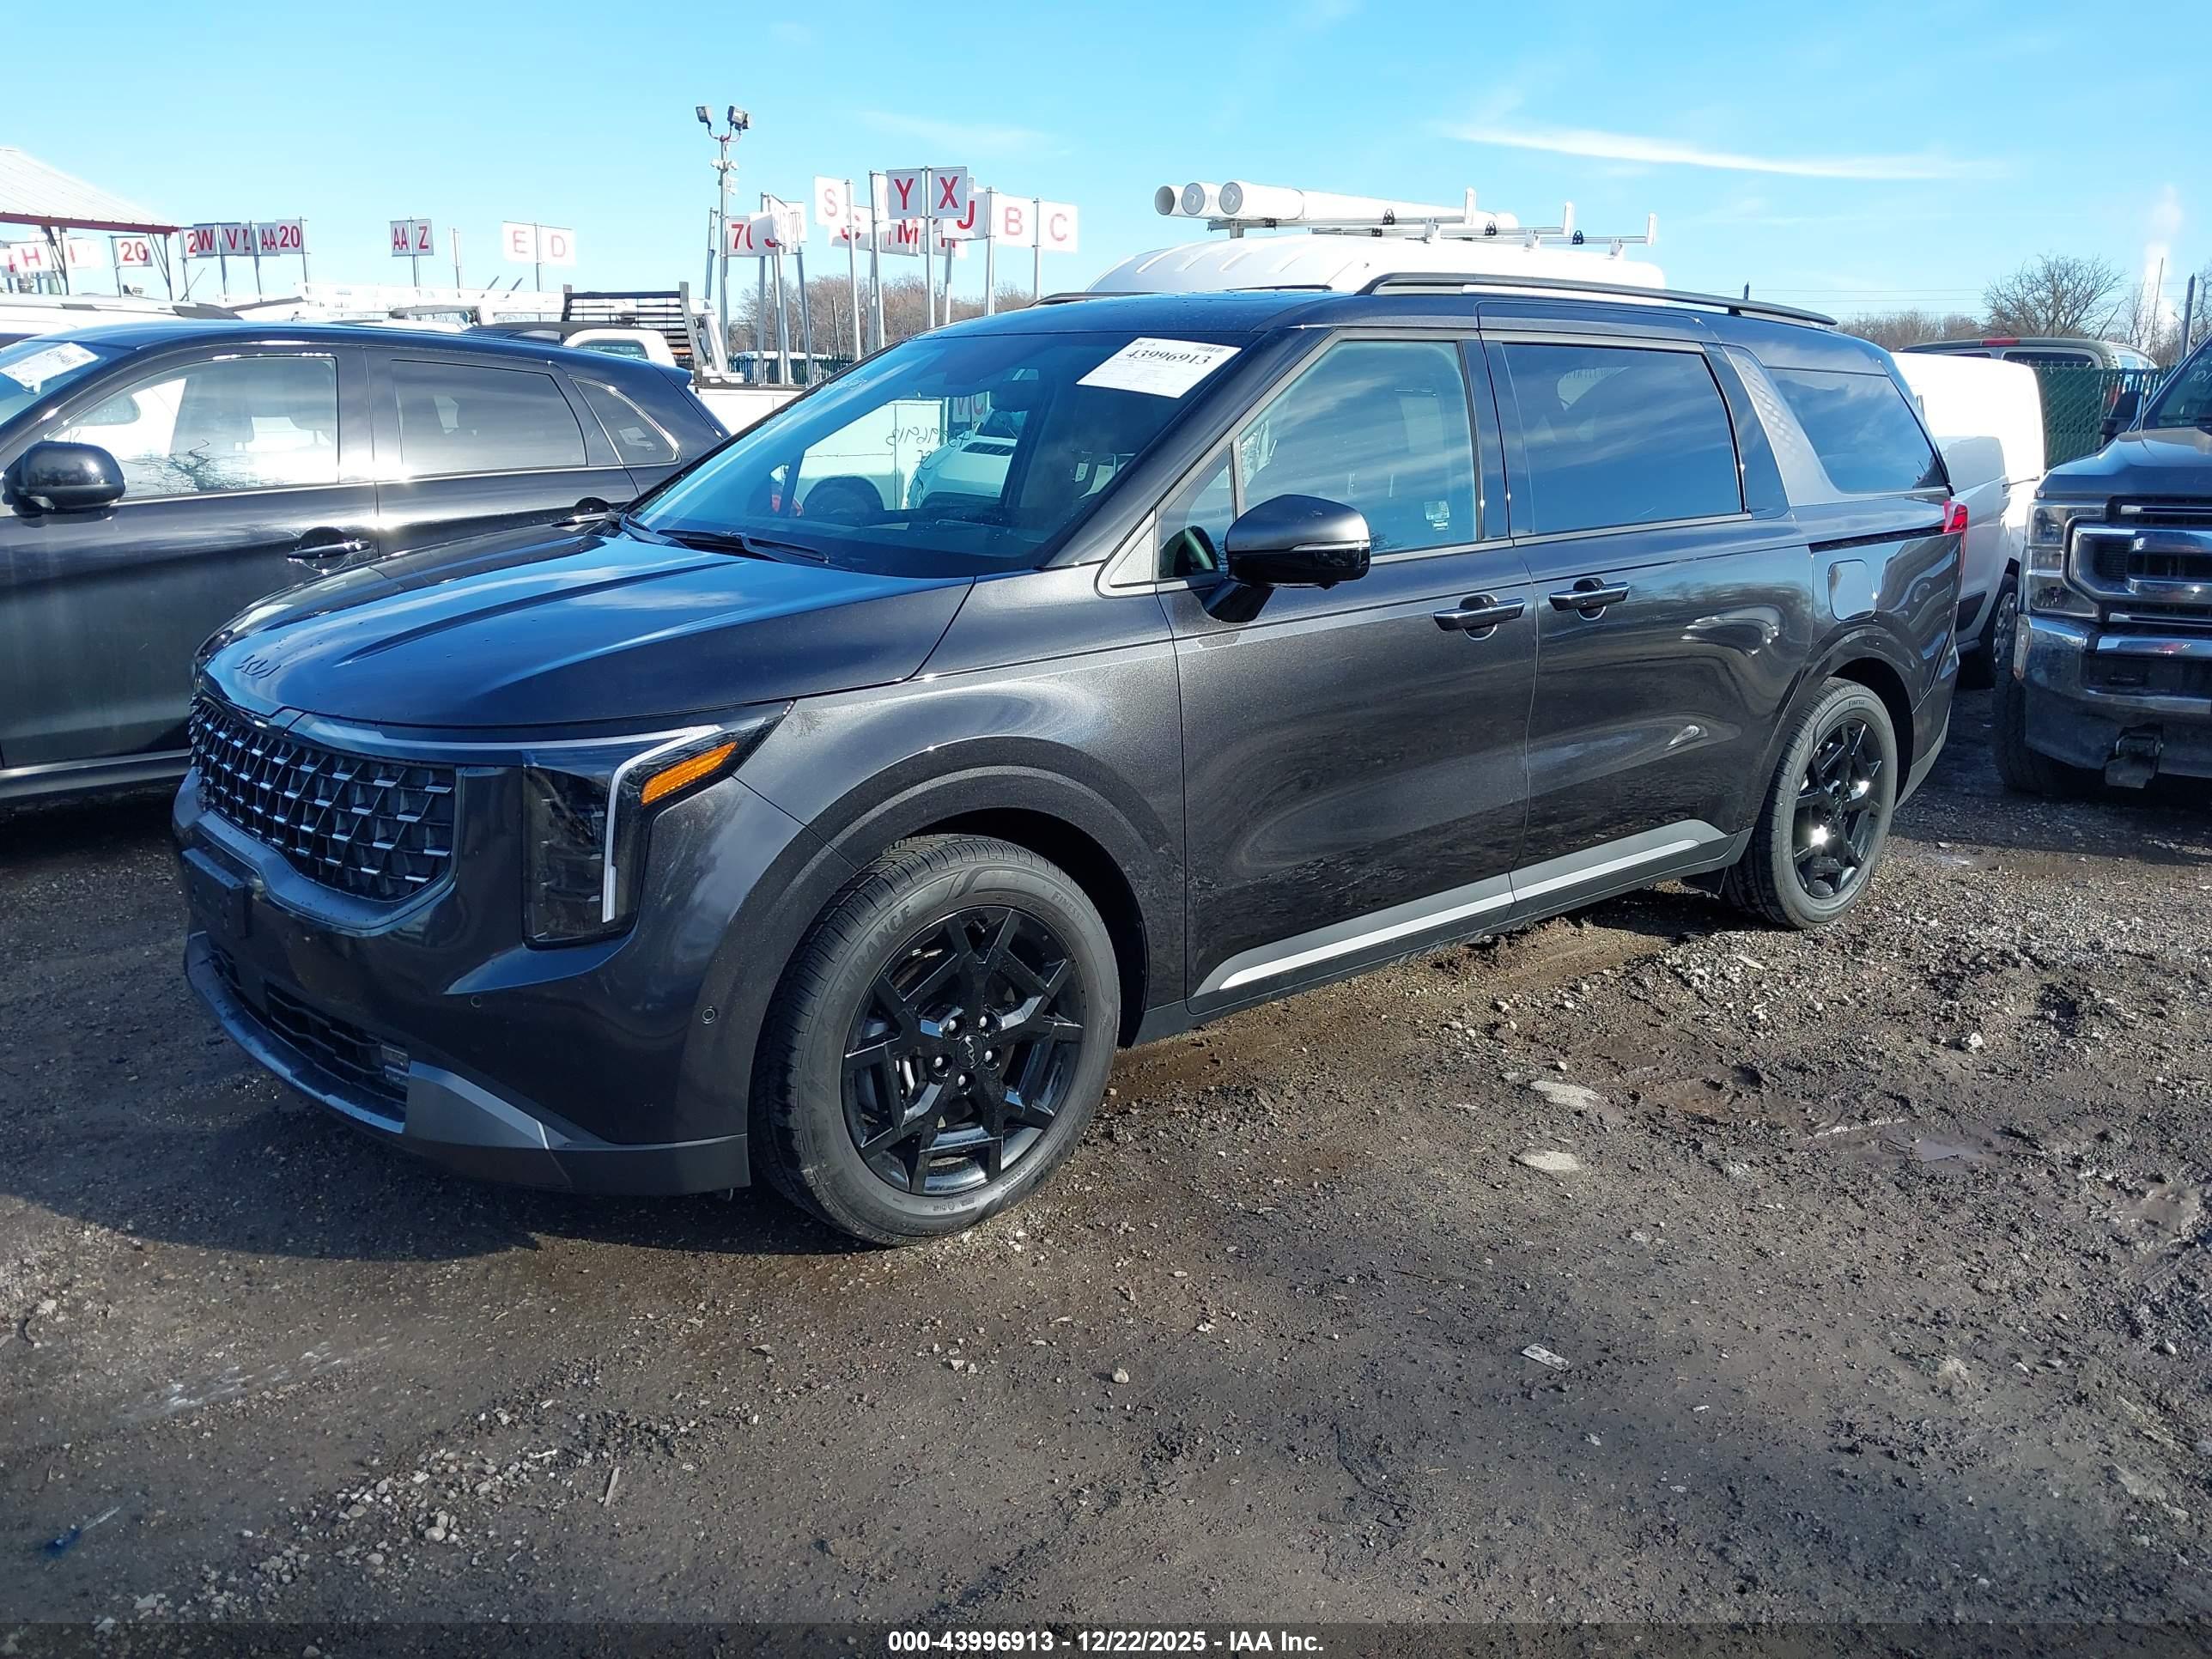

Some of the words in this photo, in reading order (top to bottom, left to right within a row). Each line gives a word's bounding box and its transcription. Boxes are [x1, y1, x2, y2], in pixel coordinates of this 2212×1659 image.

[823, 187, 838, 218] S
[894, 178, 915, 210] Y
[939, 176, 959, 210] X
[956, 199, 975, 230] J
[1004, 207, 1024, 236] B
[196, 228, 214, 251] W
[225, 228, 238, 250] V
[261, 228, 278, 251] AA
[279, 225, 301, 248] 20
[392, 228, 409, 251] AA
[418, 226, 429, 250] Z
[1049, 213, 1068, 242] C
[120, 241, 147, 262] 20
[512, 230, 528, 254] E
[550, 234, 567, 258] D
[21, 247, 41, 267] H
[1125, 349, 1212, 365] 43996913
